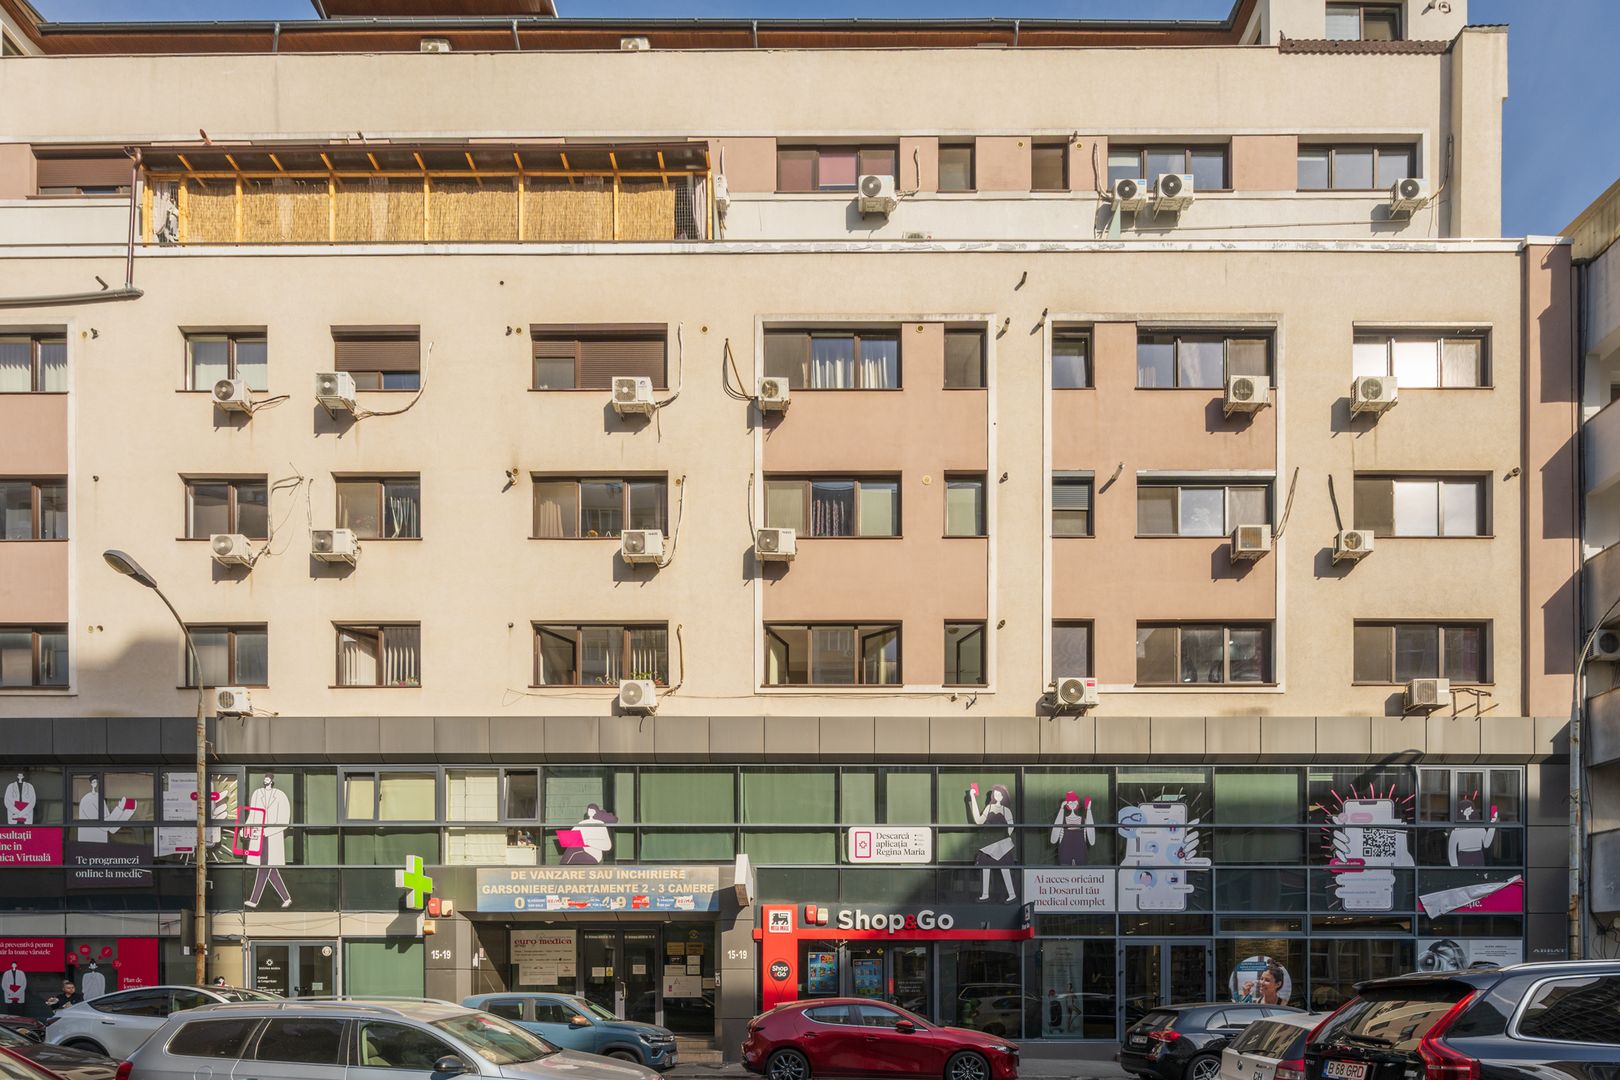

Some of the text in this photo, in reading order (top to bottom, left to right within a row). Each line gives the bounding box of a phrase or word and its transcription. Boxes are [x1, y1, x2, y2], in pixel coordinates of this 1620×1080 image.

[876, 832, 910, 840] Descarcă
[876, 840, 908, 849] aplicația
[876, 848, 926, 856] Regina Maria
[16, 853, 51, 862] Virtuală
[75, 855, 140, 866] Te programezi
[75, 869, 143, 878] online la medic
[510, 869, 686, 881] DE VANZARE SAU INCHIRIERE
[1033, 874, 1105, 884] Ai acces oricând
[481, 883, 639, 895] GARSONIERE/APARTAMENTE
[641, 883, 649, 894] 2
[658, 883, 665, 893] 3
[667, 883, 715, 894] CAMERE
[1039, 886, 1100, 895] la Dosarul tău
[1034, 897, 1106, 908] medical complet
[837, 909, 955, 935] Shop&Go
[431, 950, 452, 960] 15-19
[727, 950, 748, 960] 15-19
[771, 965, 789, 973] Shop
[1328, 1062, 1335, 1074] B
[1346, 1064, 1365, 1079] GRD
